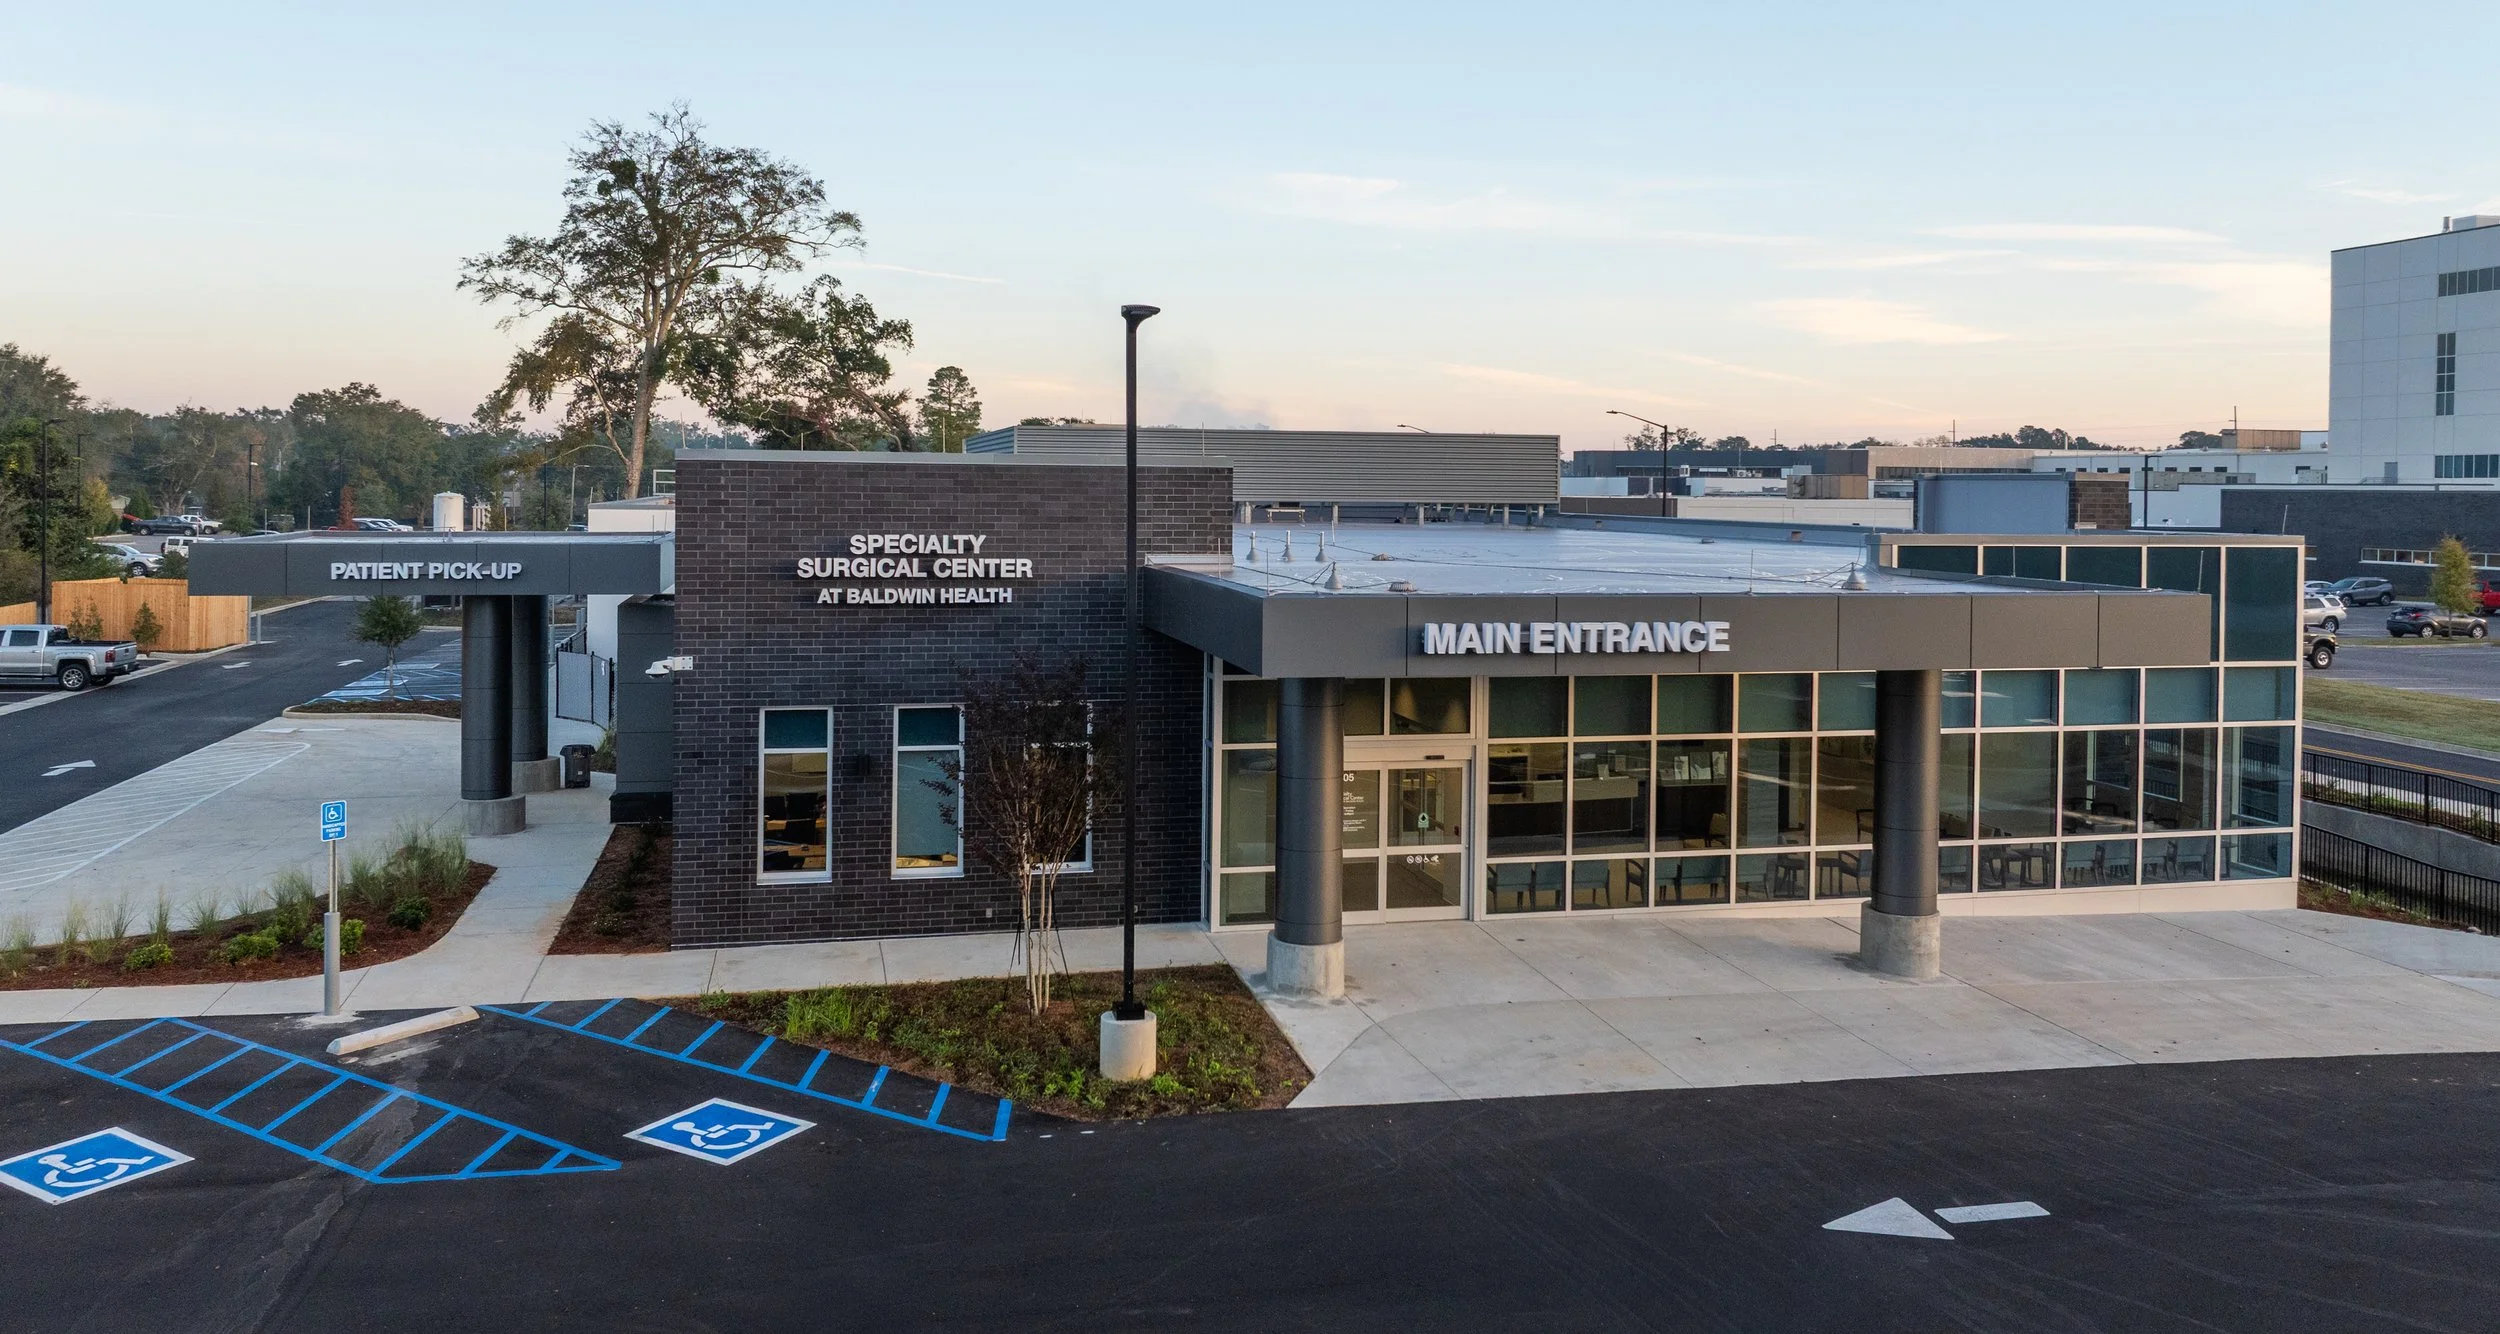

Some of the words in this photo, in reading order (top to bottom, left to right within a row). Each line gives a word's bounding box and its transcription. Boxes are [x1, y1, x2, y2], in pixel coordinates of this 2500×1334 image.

[850, 534, 987, 554] SPECIALTY
[331, 562, 424, 580] PATIENT
[428, 562, 523, 580] PICK-UP
[797, 557, 927, 578] SURGICAL
[933, 557, 1033, 578] CENTER
[817, 588, 843, 604] AT
[846, 587, 936, 604] BALDWIN
[940, 587, 1013, 604] HEALTH
[1424, 622, 1521, 654] MAIN
[1530, 621, 1731, 654] ENTRANCE
